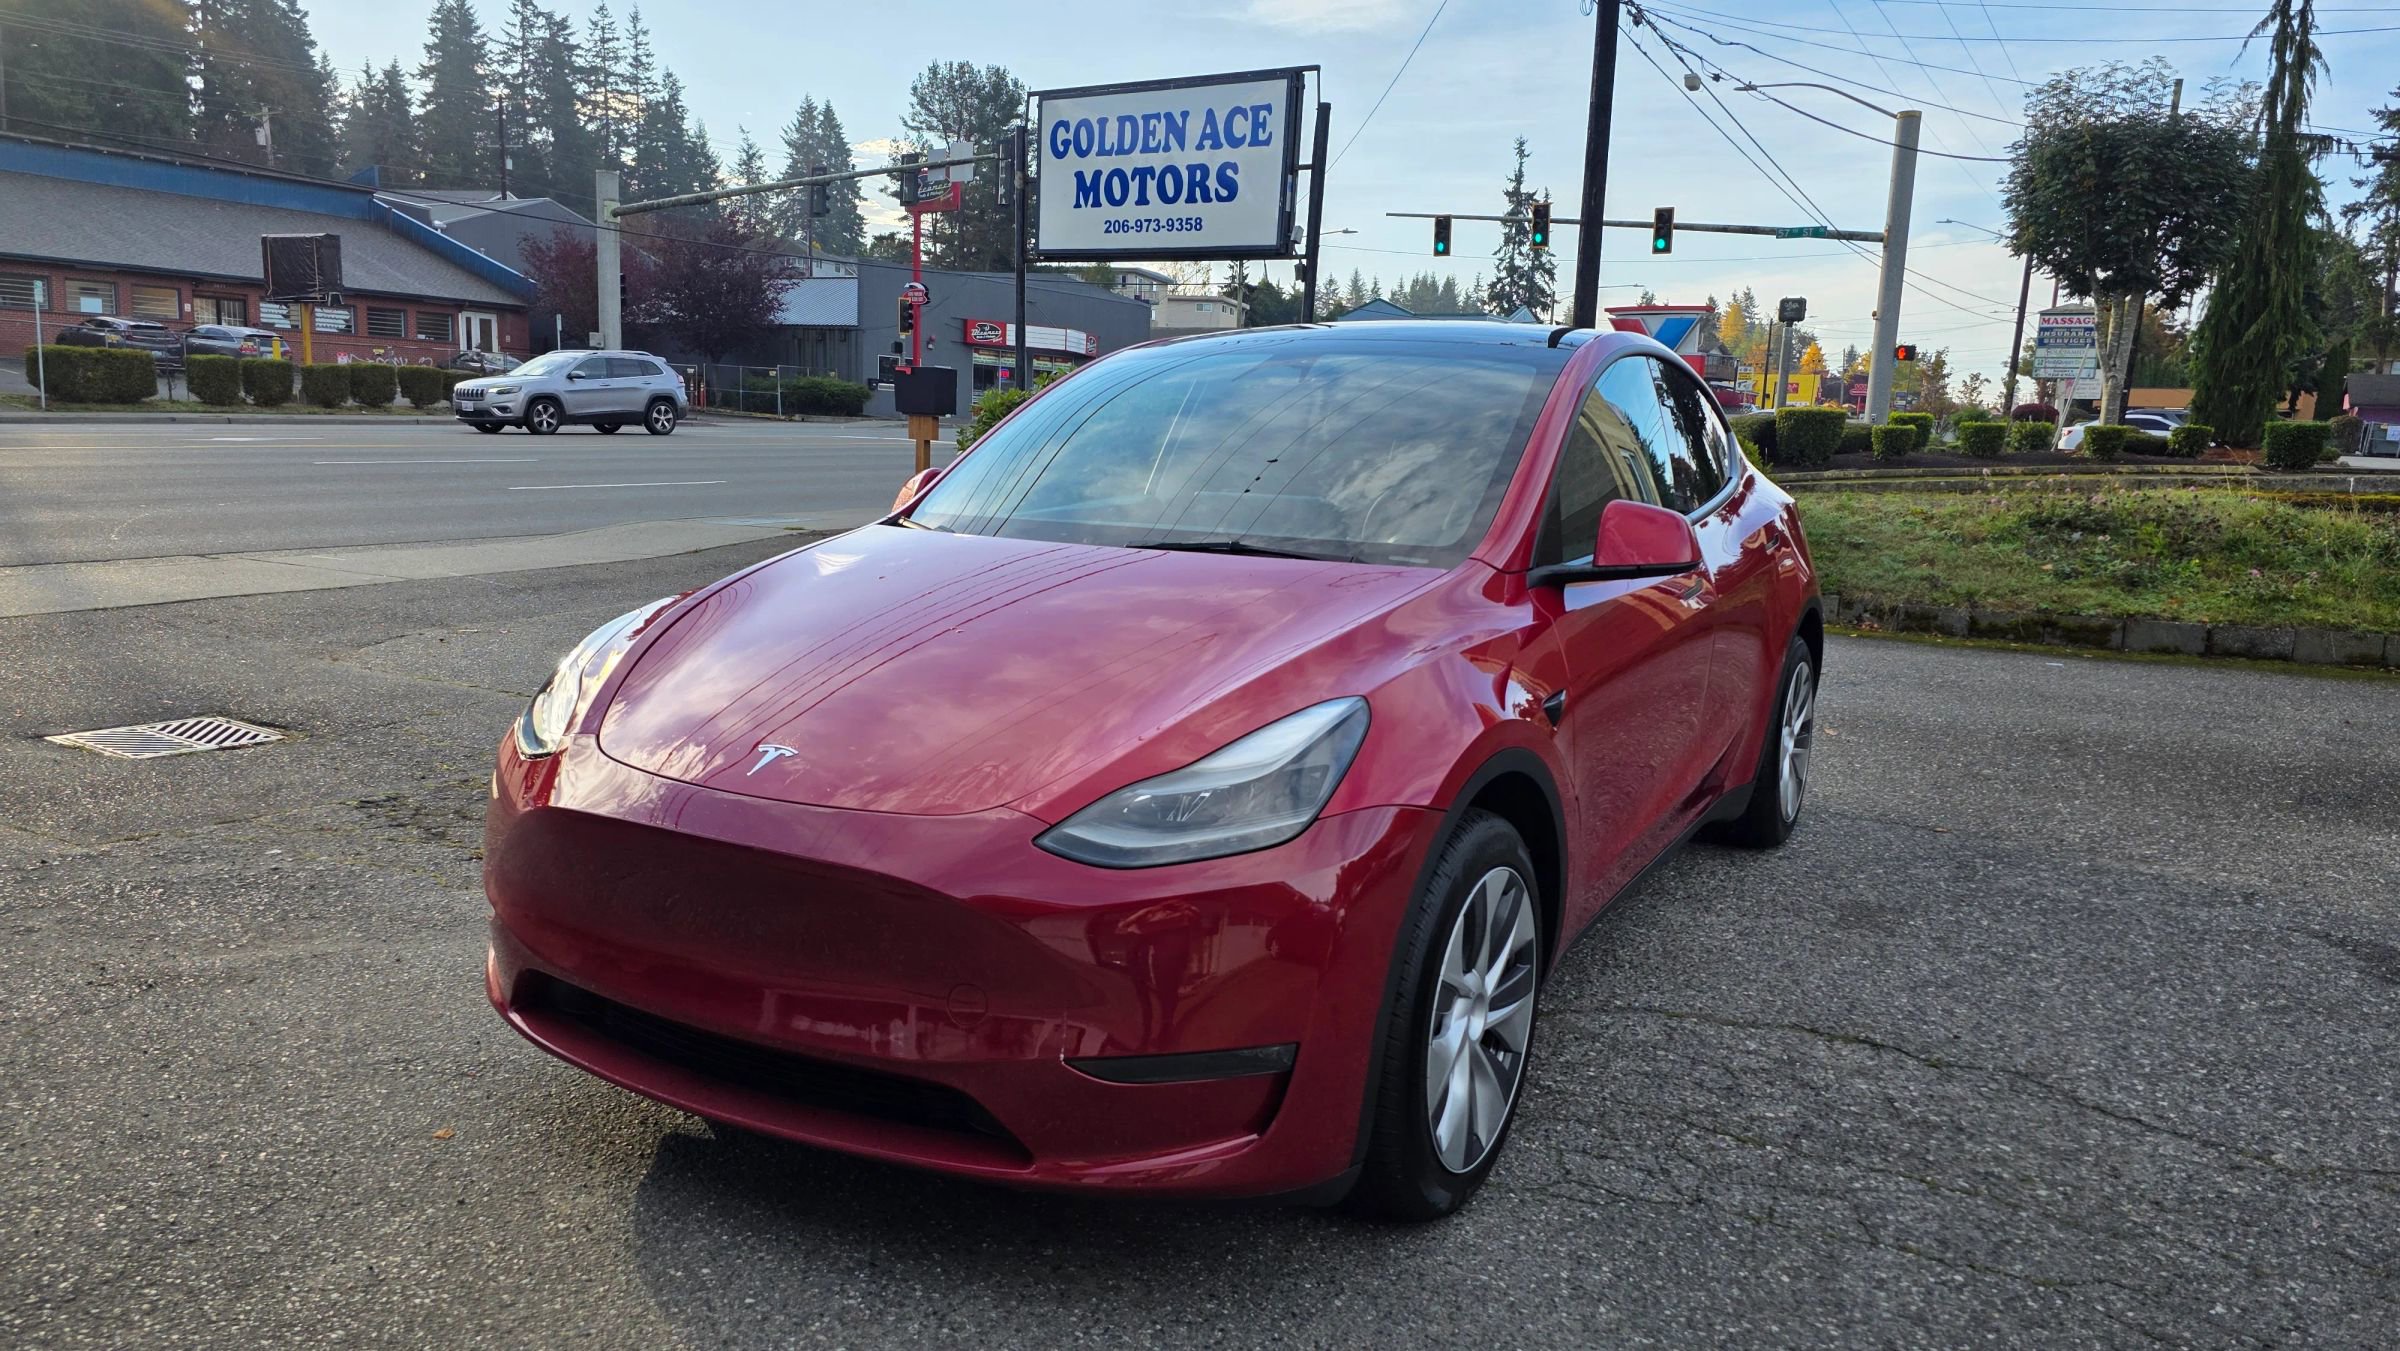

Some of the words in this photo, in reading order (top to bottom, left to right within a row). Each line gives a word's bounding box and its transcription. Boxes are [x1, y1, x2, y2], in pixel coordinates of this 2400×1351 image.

[1050, 110, 1190, 159] GOLDEN
[1195, 102, 1273, 150] ACE
[1073, 161, 1239, 209] MOTORS
[1104, 216, 1203, 234] 206-973-9358
[1803, 227, 1813, 237] ST
